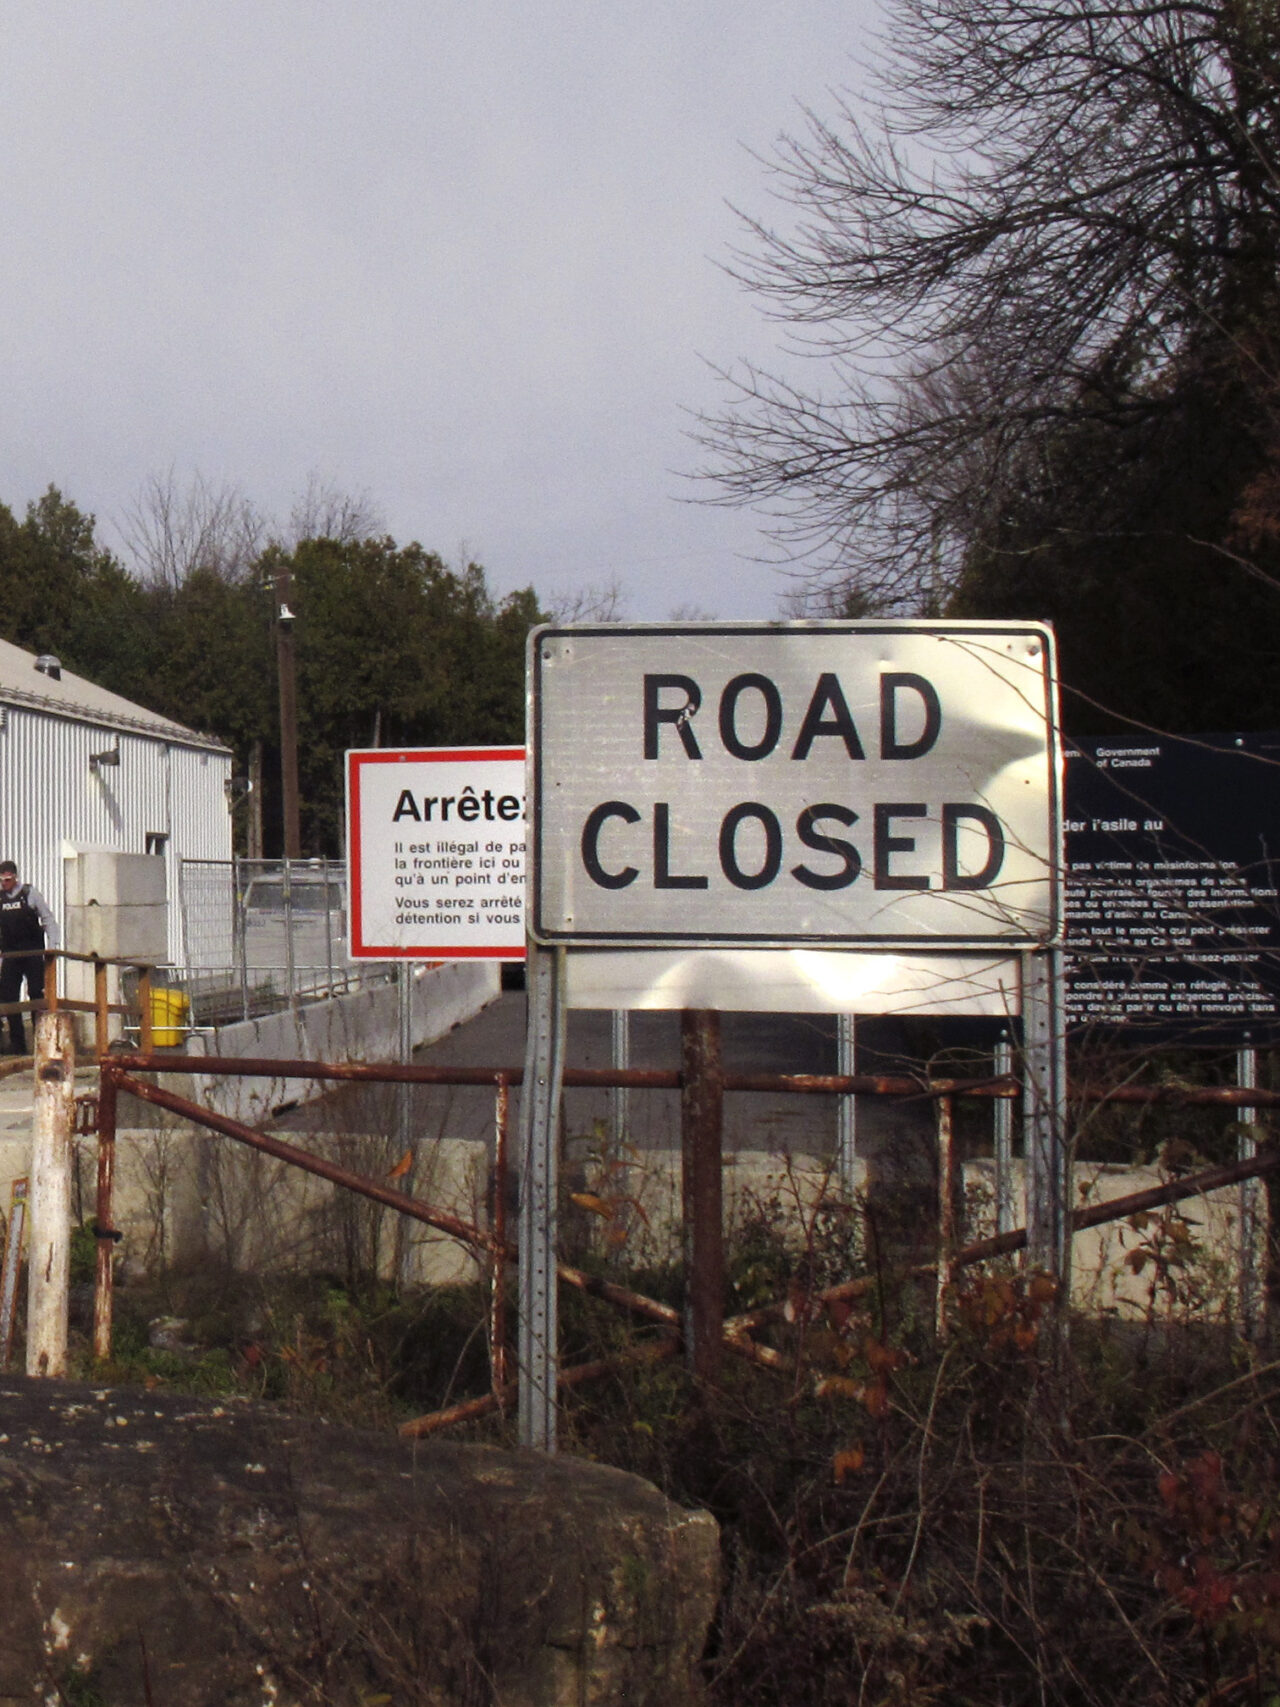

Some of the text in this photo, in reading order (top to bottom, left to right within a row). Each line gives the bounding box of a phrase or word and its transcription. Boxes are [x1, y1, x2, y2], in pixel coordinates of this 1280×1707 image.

[642, 672, 942, 761] ROAD
[1096, 747, 1160, 758] Government
[1111, 758, 1152, 768] Canada
[393, 786, 526, 822] Arrête
[1144, 820, 1164, 831] au
[409, 843, 431, 853] est
[437, 841, 479, 856] illégal
[485, 841, 503, 853] de
[581, 801, 1006, 892] CLOSED
[395, 857, 520, 869] la frontière ici ou
[395, 873, 425, 887] qu'à
[432, 876, 449, 885] un
[455, 873, 492, 887] point
[2, 901, 21, 911] POLICE
[395, 896, 523, 908] Vous serez arrêté
[395, 912, 521, 924] détention si vous
